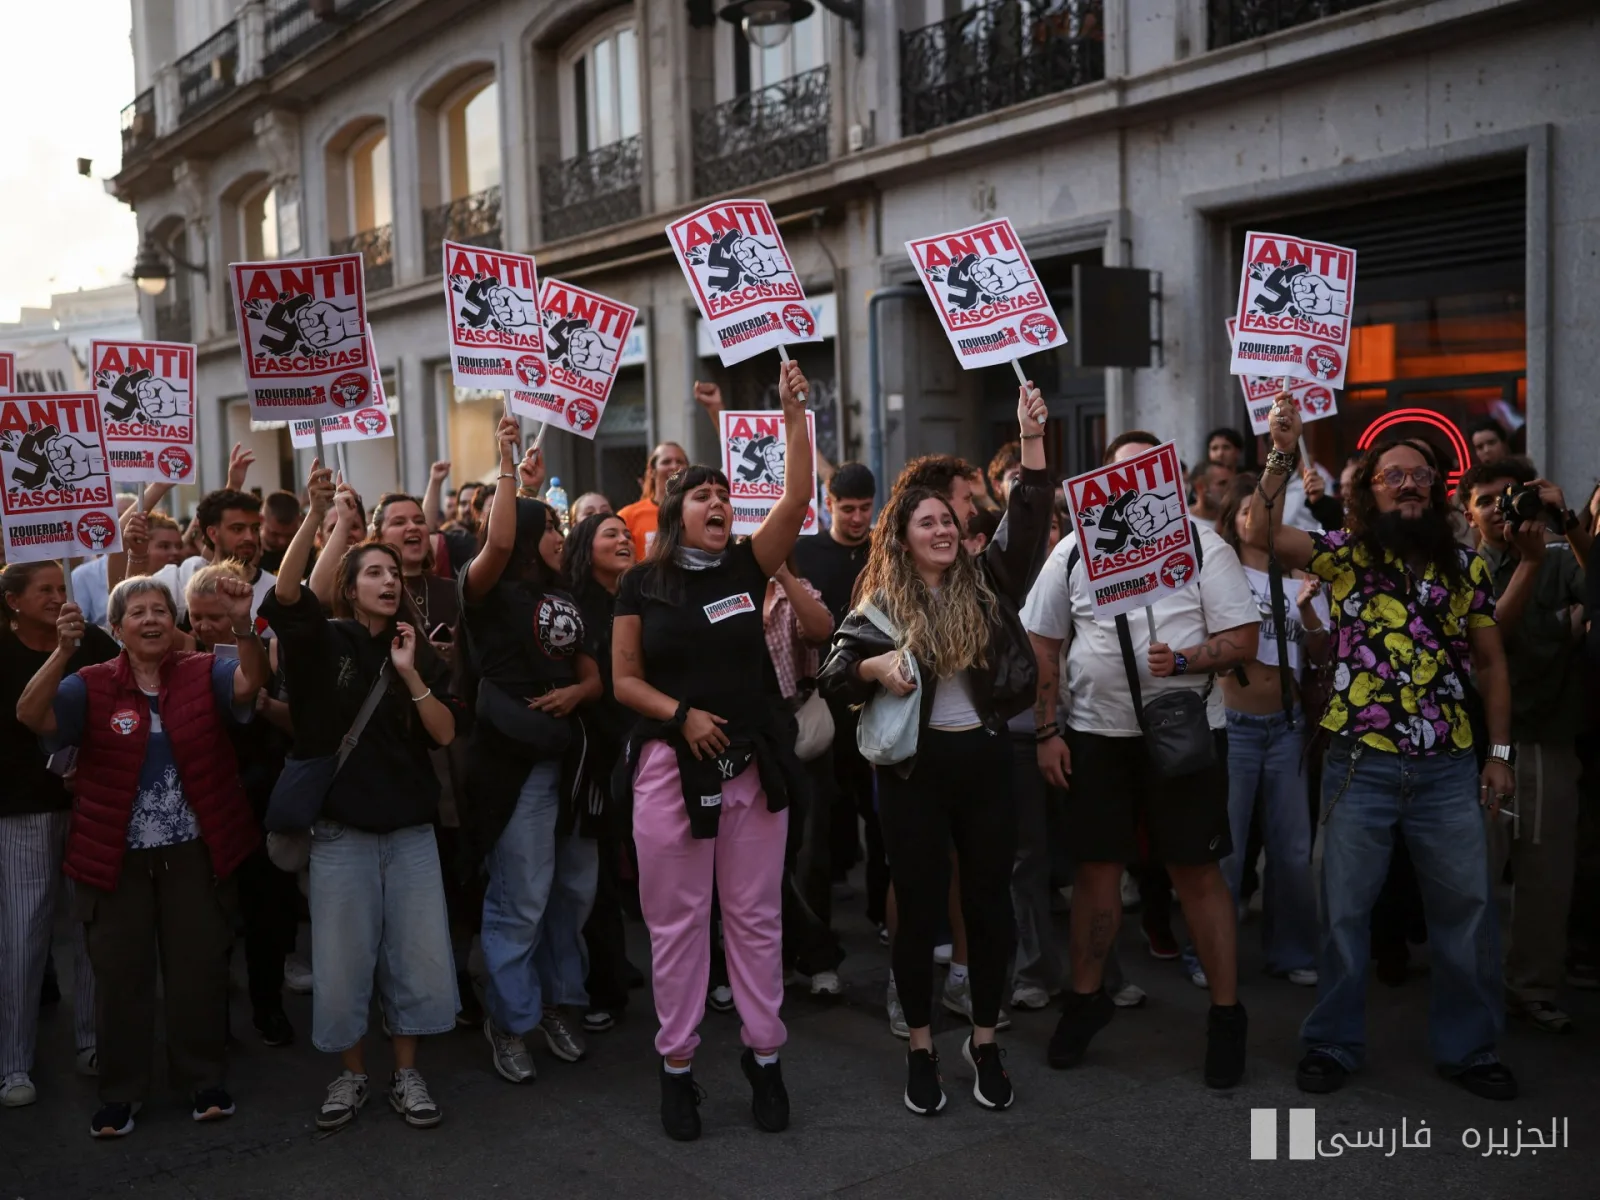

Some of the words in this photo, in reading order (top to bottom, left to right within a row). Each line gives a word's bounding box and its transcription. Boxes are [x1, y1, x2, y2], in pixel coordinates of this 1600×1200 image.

[686, 207, 772, 251] ANTI
[926, 226, 1014, 267] ANTI
[452, 252, 532, 289] ANTI
[1252, 240, 1348, 280] ANTI
[246, 262, 355, 304] ANTI
[708, 282, 798, 313] FASCISTAS
[949, 292, 1040, 325] FASCISTAS
[544, 289, 629, 338] ANTI
[457, 328, 540, 347] FASCISTAS
[717, 314, 768, 341] IZQUIERDA
[721, 321, 784, 349] REVOLUCIONARIA
[1245, 314, 1342, 339] FASCISTAS
[958, 330, 1006, 349] IZQUIERDA
[962, 336, 1020, 356] REVOLUCIONARIA
[1239, 342, 1290, 355] IZQUIERDA
[97, 347, 188, 379] ANTI
[254, 348, 362, 372] FASCISTAS
[457, 356, 502, 368] IZQUIERDA
[1238, 352, 1303, 364] REVOLUCIONARIA
[458, 366, 514, 376] REVOLUCIONARIA
[549, 364, 605, 395] CISTAS
[255, 388, 312, 399] IZQUIERDA
[256, 395, 327, 407] REVOLUCIONARIA
[0, 400, 97, 434] ANTI
[294, 417, 339, 430] IZQURDA
[105, 423, 189, 438] ASCISTAS
[109, 450, 142, 461] UIERDA
[732, 482, 785, 496] FASCIS
[1080, 452, 1174, 510] ANTI
[8, 487, 107, 508] FASCISTAS
[733, 506, 771, 517] ZQUIERDA
[9, 523, 64, 537] IZQUIERDA
[11, 533, 75, 547] REVOLUCIONARIA
[1091, 529, 1184, 575] FASCISTAS
[1095, 576, 1146, 599] IZQUIERDA
[1097, 581, 1159, 606] REVOLUCIONARIA
[706, 596, 742, 615] IZQUIERDA
